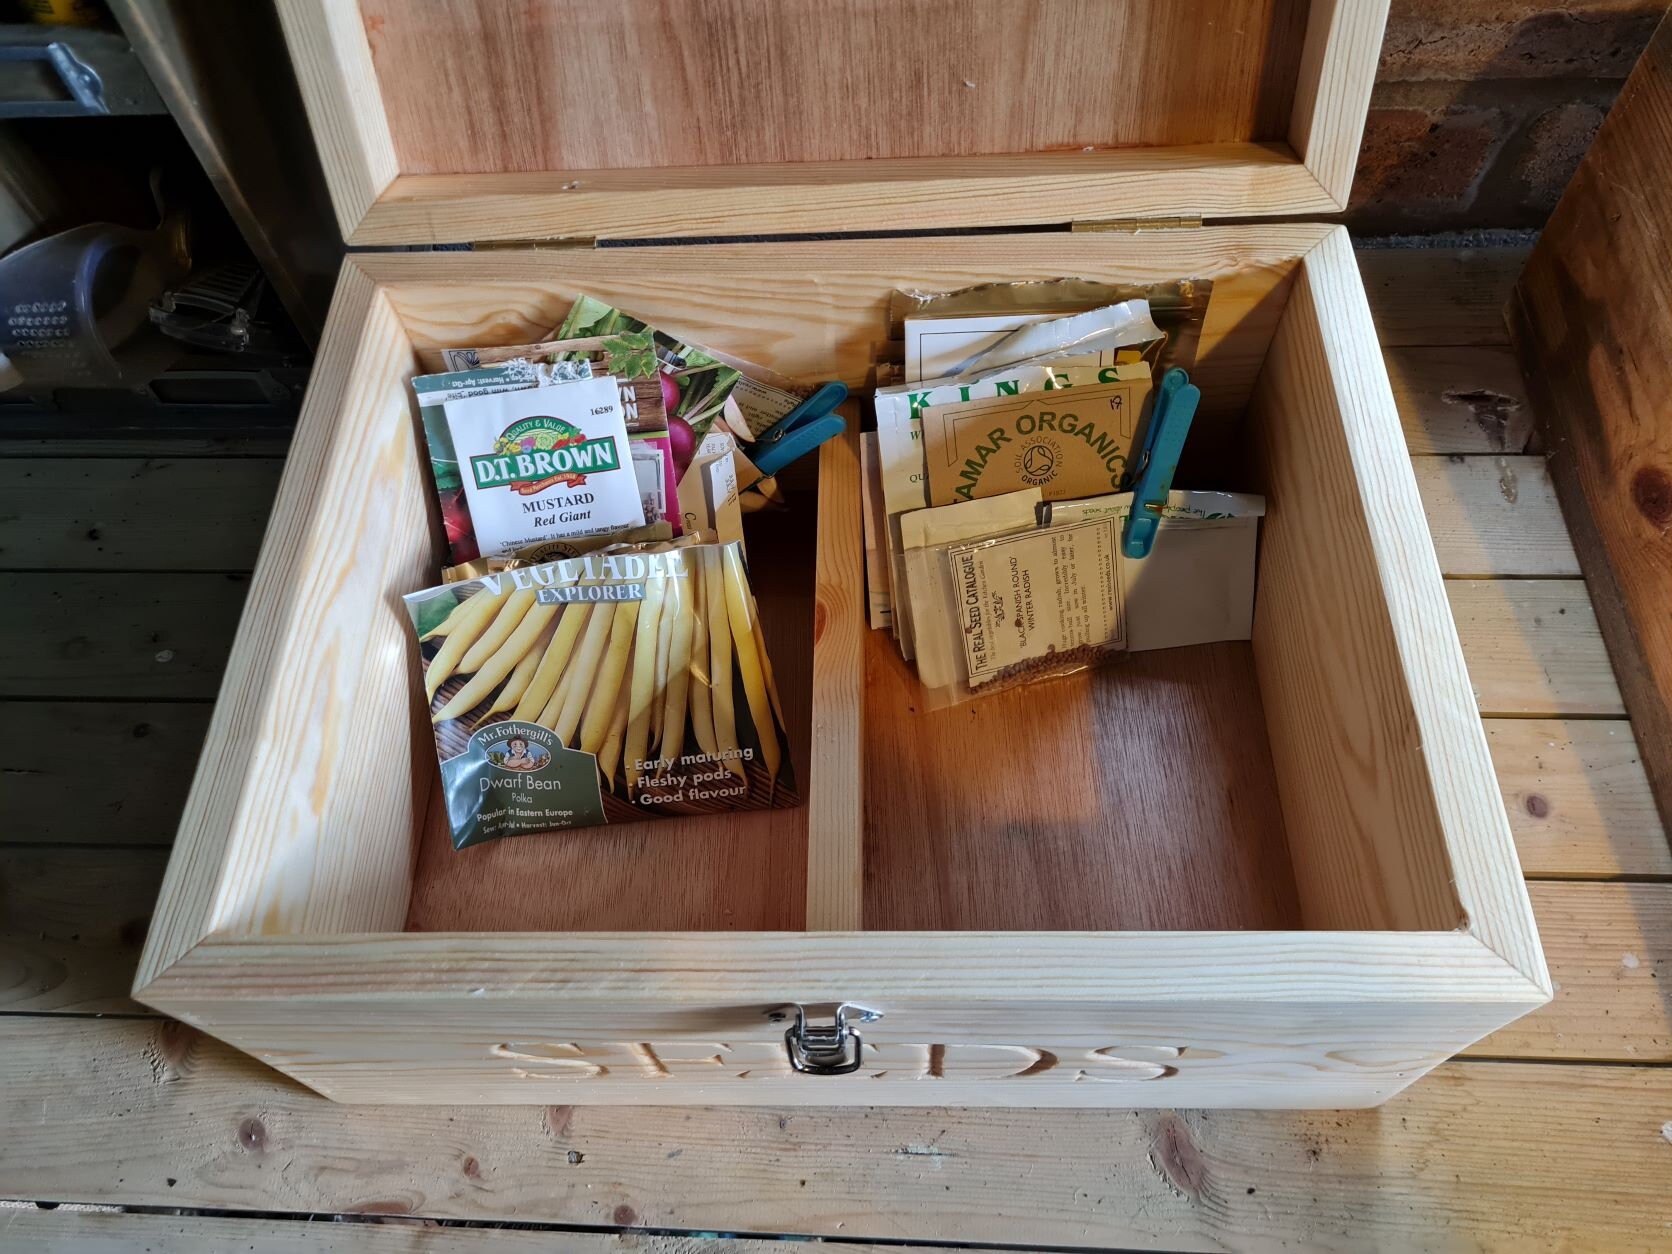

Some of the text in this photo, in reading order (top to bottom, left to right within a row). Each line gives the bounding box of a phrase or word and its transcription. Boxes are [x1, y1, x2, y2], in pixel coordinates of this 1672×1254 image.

[590, 405, 614, 416] 16289
[517, 442, 613, 477] BROWN
[953, 411, 1132, 503] AMAR ORGANICS
[1015, 435, 1063, 473] SOIL ASSOCIATION
[1021, 470, 1057, 486] ORGANIC
[522, 492, 595, 514] MUSTARD
[534, 509, 592, 528] Red Giant
[537, 584, 643, 603] EXPLORER
[1022, 570, 1035, 631] WINTER RADISH
[962, 555, 988, 670] THE REAL SEED CATALOGUE
[1014, 590, 1025, 620] SPANISH
[635, 747, 754, 771] Early maturing
[480, 773, 562, 792] Dwarf Bean
[637, 766, 732, 789] Fleshy pods
[511, 792, 533, 804] Polka
[640, 785, 746, 805] Good flavour
[477, 807, 573, 822] Popular in Eastern Europe
